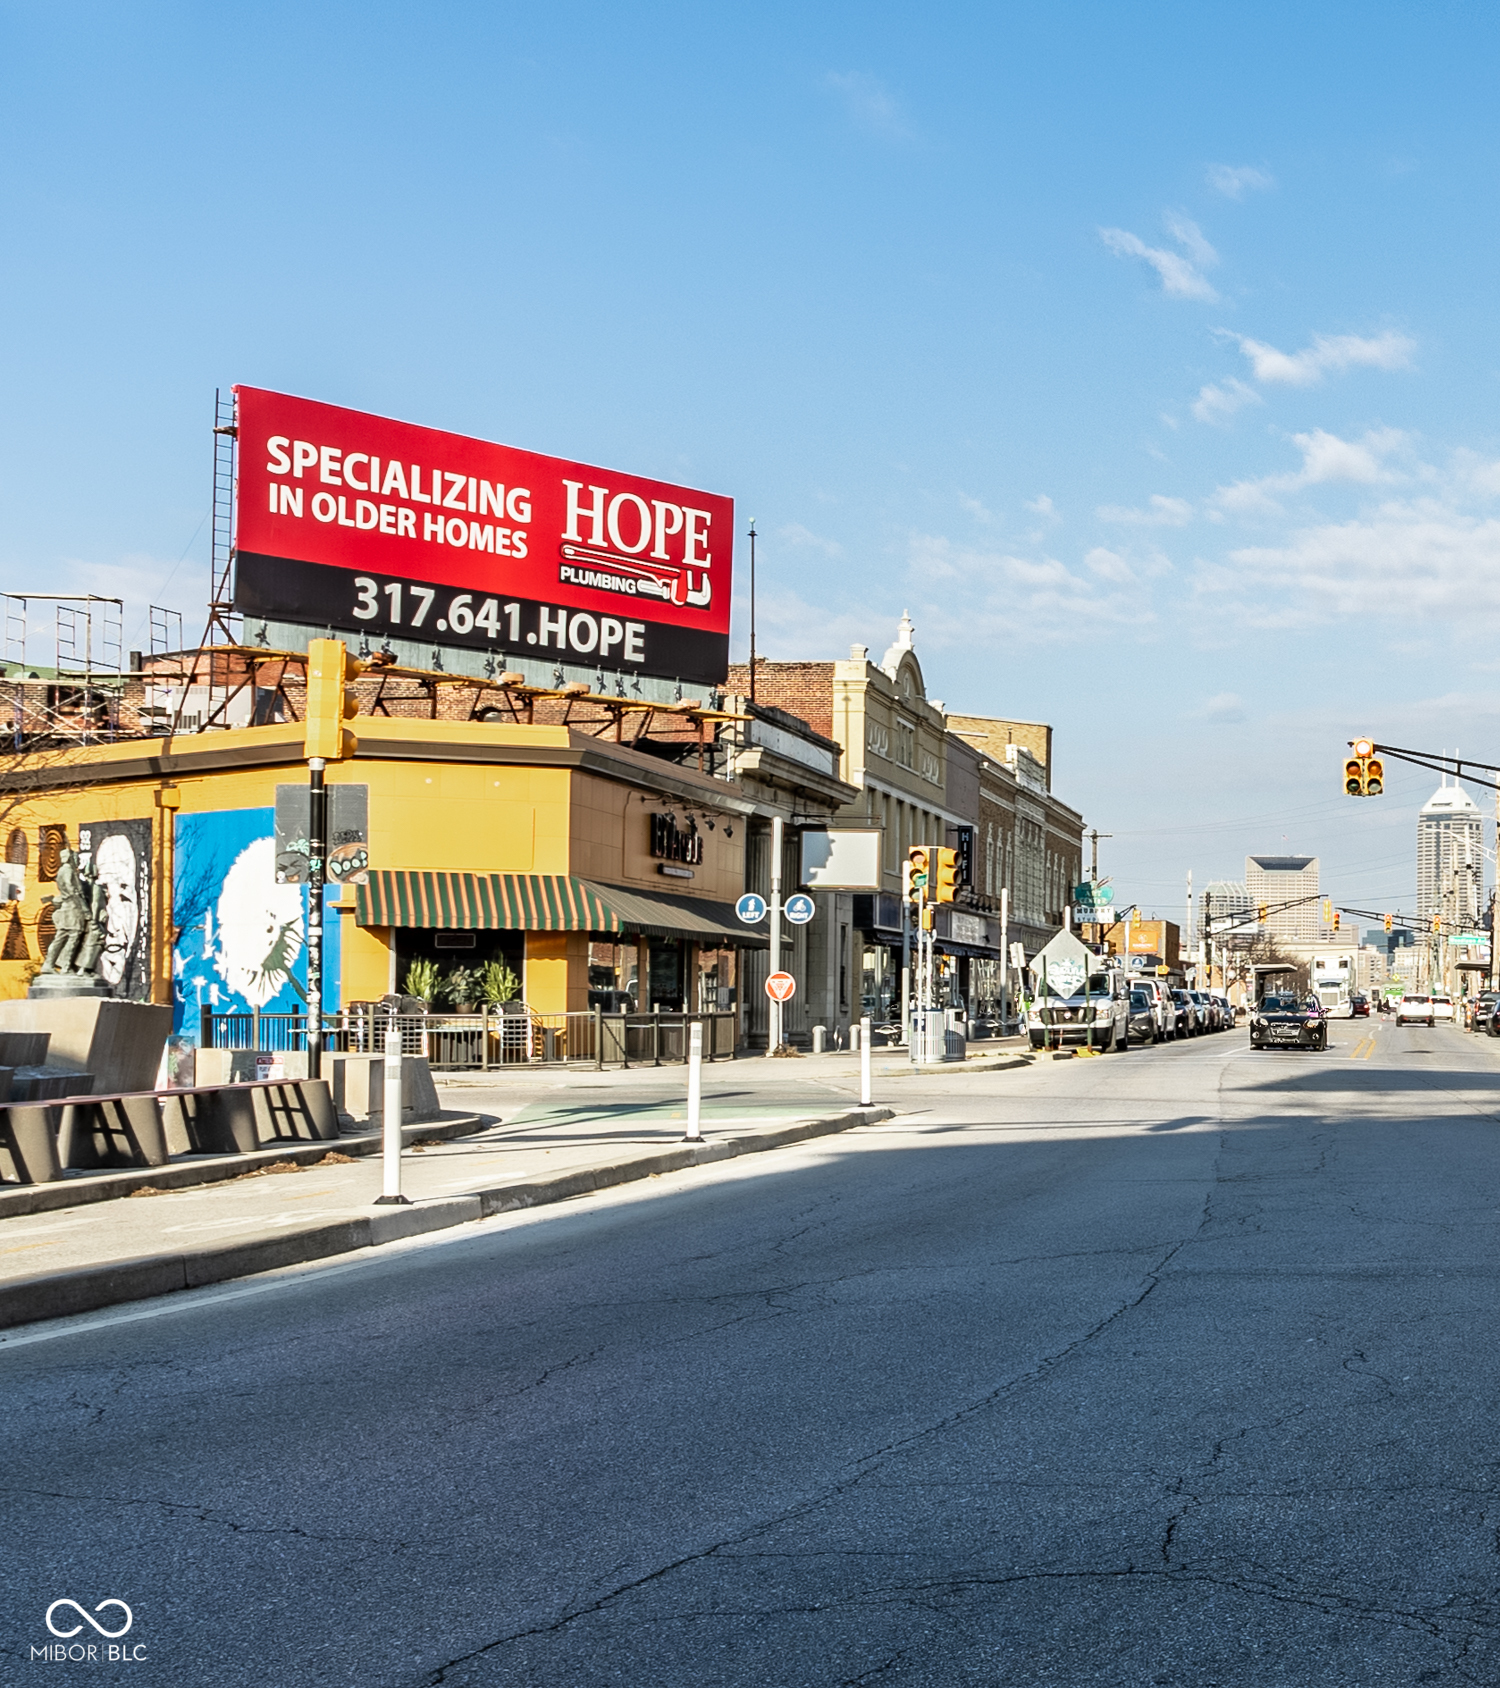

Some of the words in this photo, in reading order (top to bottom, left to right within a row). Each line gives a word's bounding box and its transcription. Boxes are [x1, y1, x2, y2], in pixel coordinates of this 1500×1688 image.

[266, 435, 532, 524] SPECIALIZING
[269, 482, 303, 518] IN
[311, 491, 416, 538] OLDER
[423, 514, 528, 560] HOMES
[561, 479, 712, 568] HOPE
[353, 577, 645, 662] 317.641.HOPE
[560, 566, 637, 594] PLUMBING
[742, 911, 760, 919] LEFT
